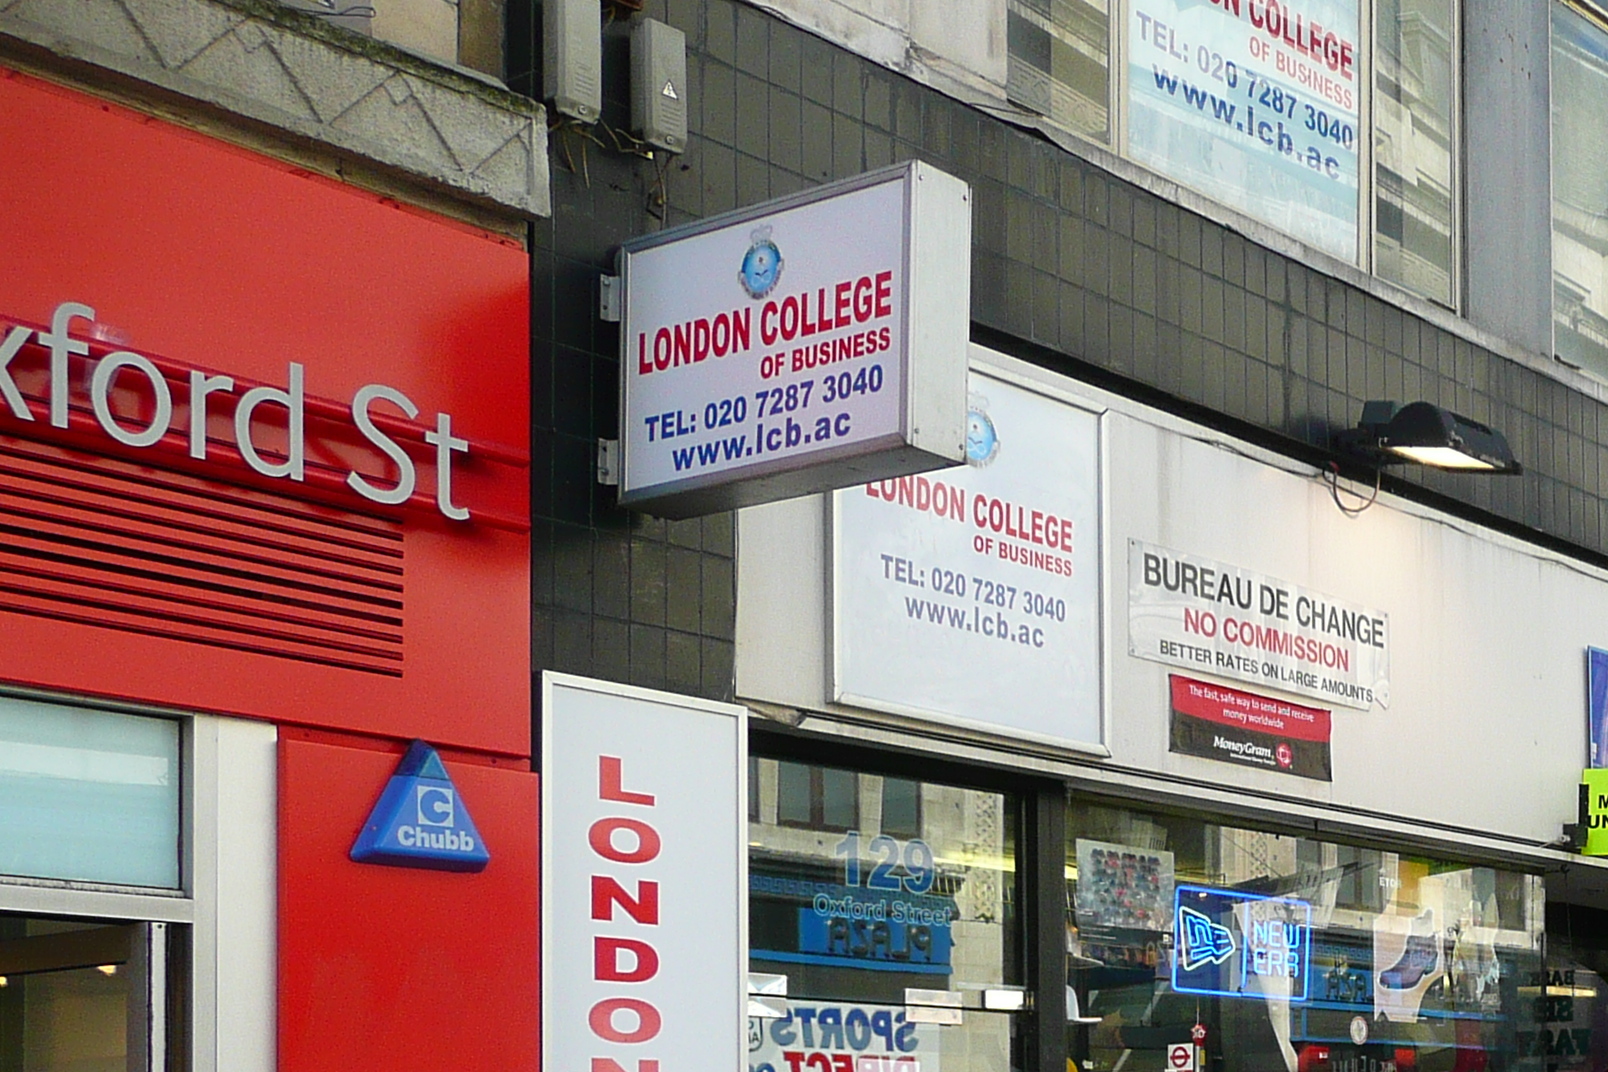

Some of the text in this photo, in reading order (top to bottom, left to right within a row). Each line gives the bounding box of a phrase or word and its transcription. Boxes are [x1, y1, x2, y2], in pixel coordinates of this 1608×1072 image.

[1249, 0, 1352, 81] COLLEGE
[1136, 10, 1352, 150] TEL: 020 7287 3040
[1250, 36, 1351, 110] OF BUSINESS
[1152, 63, 1339, 180] www.lcb.ac
[638, 270, 892, 375] LONDON COLLEGE
[760, 327, 891, 379] OF BUSINESS
[645, 364, 883, 442] TEL: 020 7287 3040
[346, 383, 470, 521] St
[672, 412, 850, 471] www.lcb.ac
[865, 475, 1072, 552] LONDON COLLEGE
[973, 535, 1072, 577] OF BUSINESS
[881, 554, 1066, 622] TEL: 020 7287 3040
[1144, 552, 1384, 648] BUREAU DE CHANGE
[905, 596, 1044, 647] www.lcb.ac
[1184, 607, 1349, 672] NO COMMISSION
[1160, 639, 1372, 702] BETTER RATES ON LARGE AMOUNTS
[1189, 685, 1314, 722] The fast, safe way to send and receive
[1223, 708, 1284, 729] money worldwide
[398, 825, 474, 851] Chubb
[836, 831, 934, 894] 129
[813, 893, 952, 926] Oxford Street
[1252, 920, 1301, 949] NEW
[1253, 952, 1299, 978] ERA
